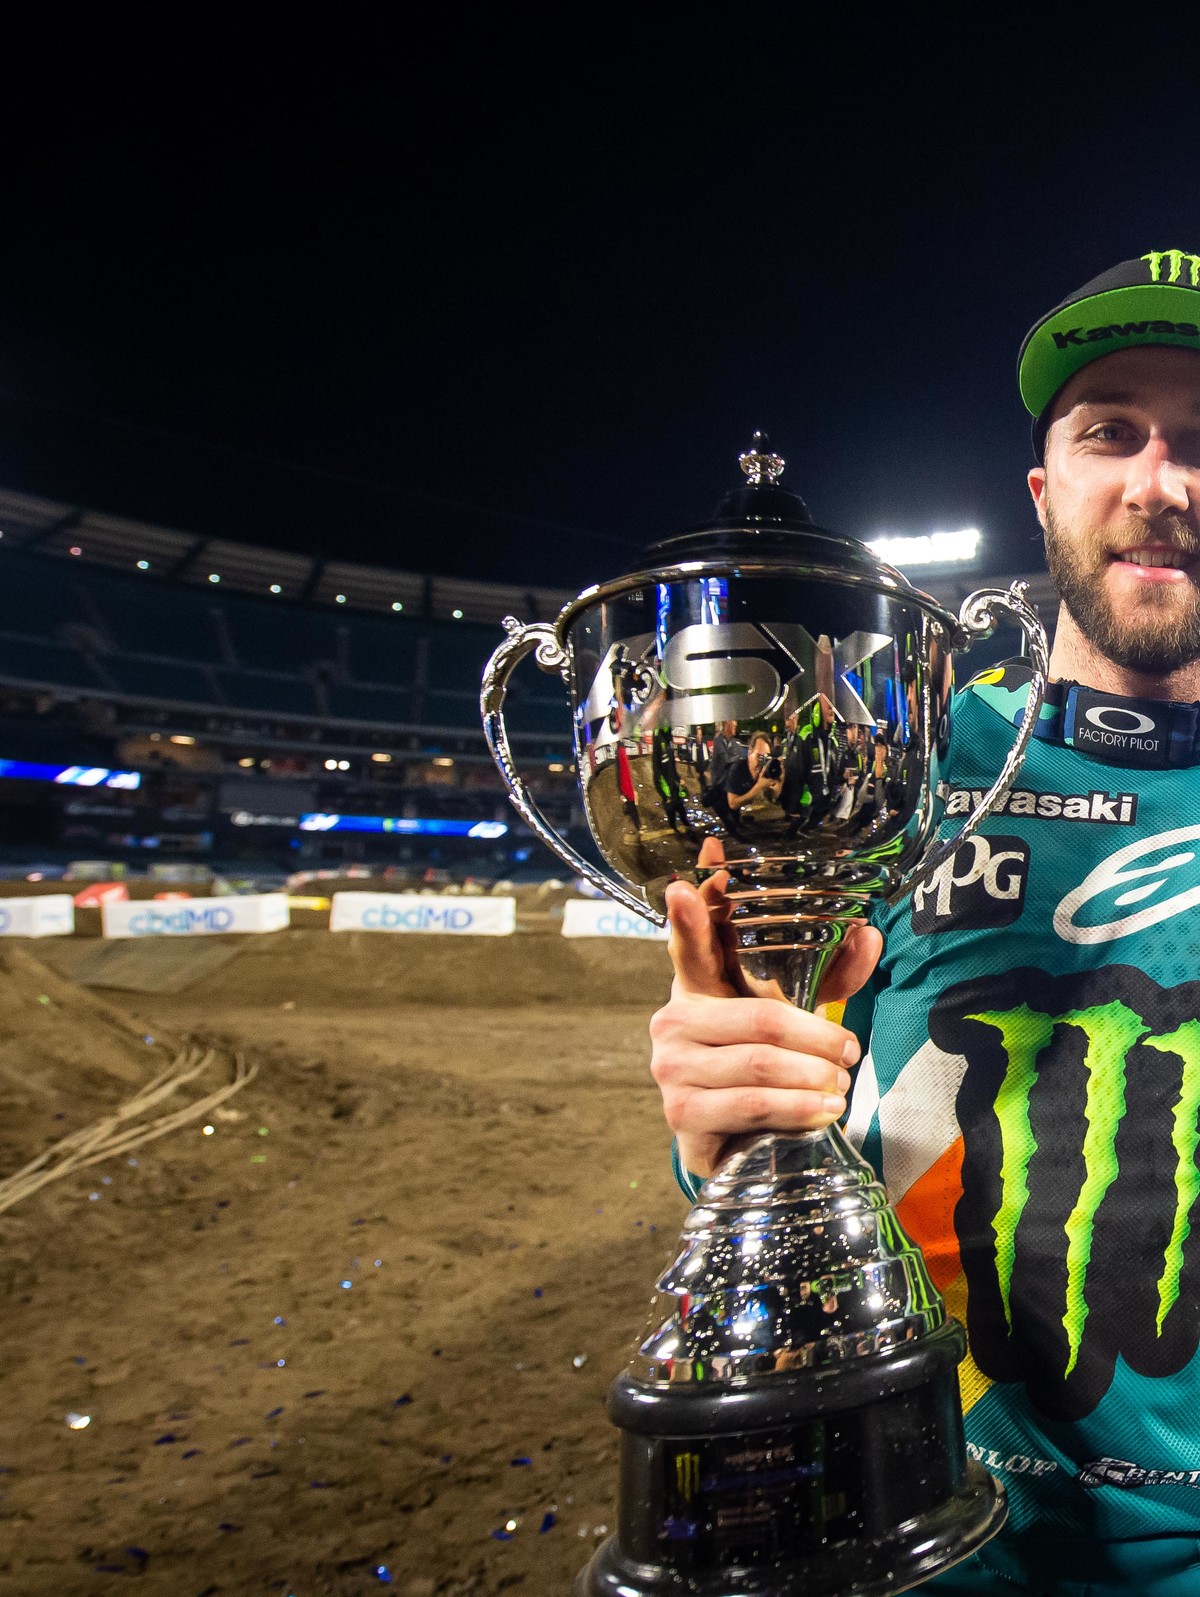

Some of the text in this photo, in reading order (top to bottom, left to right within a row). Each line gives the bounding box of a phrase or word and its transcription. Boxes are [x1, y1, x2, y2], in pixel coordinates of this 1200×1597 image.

[1078, 727, 1160, 751] FACTORY PILOT
[945, 790, 1133, 823] awasaki
[128, 907, 235, 936] cbdMD
[361, 903, 474, 930] cbdMD
